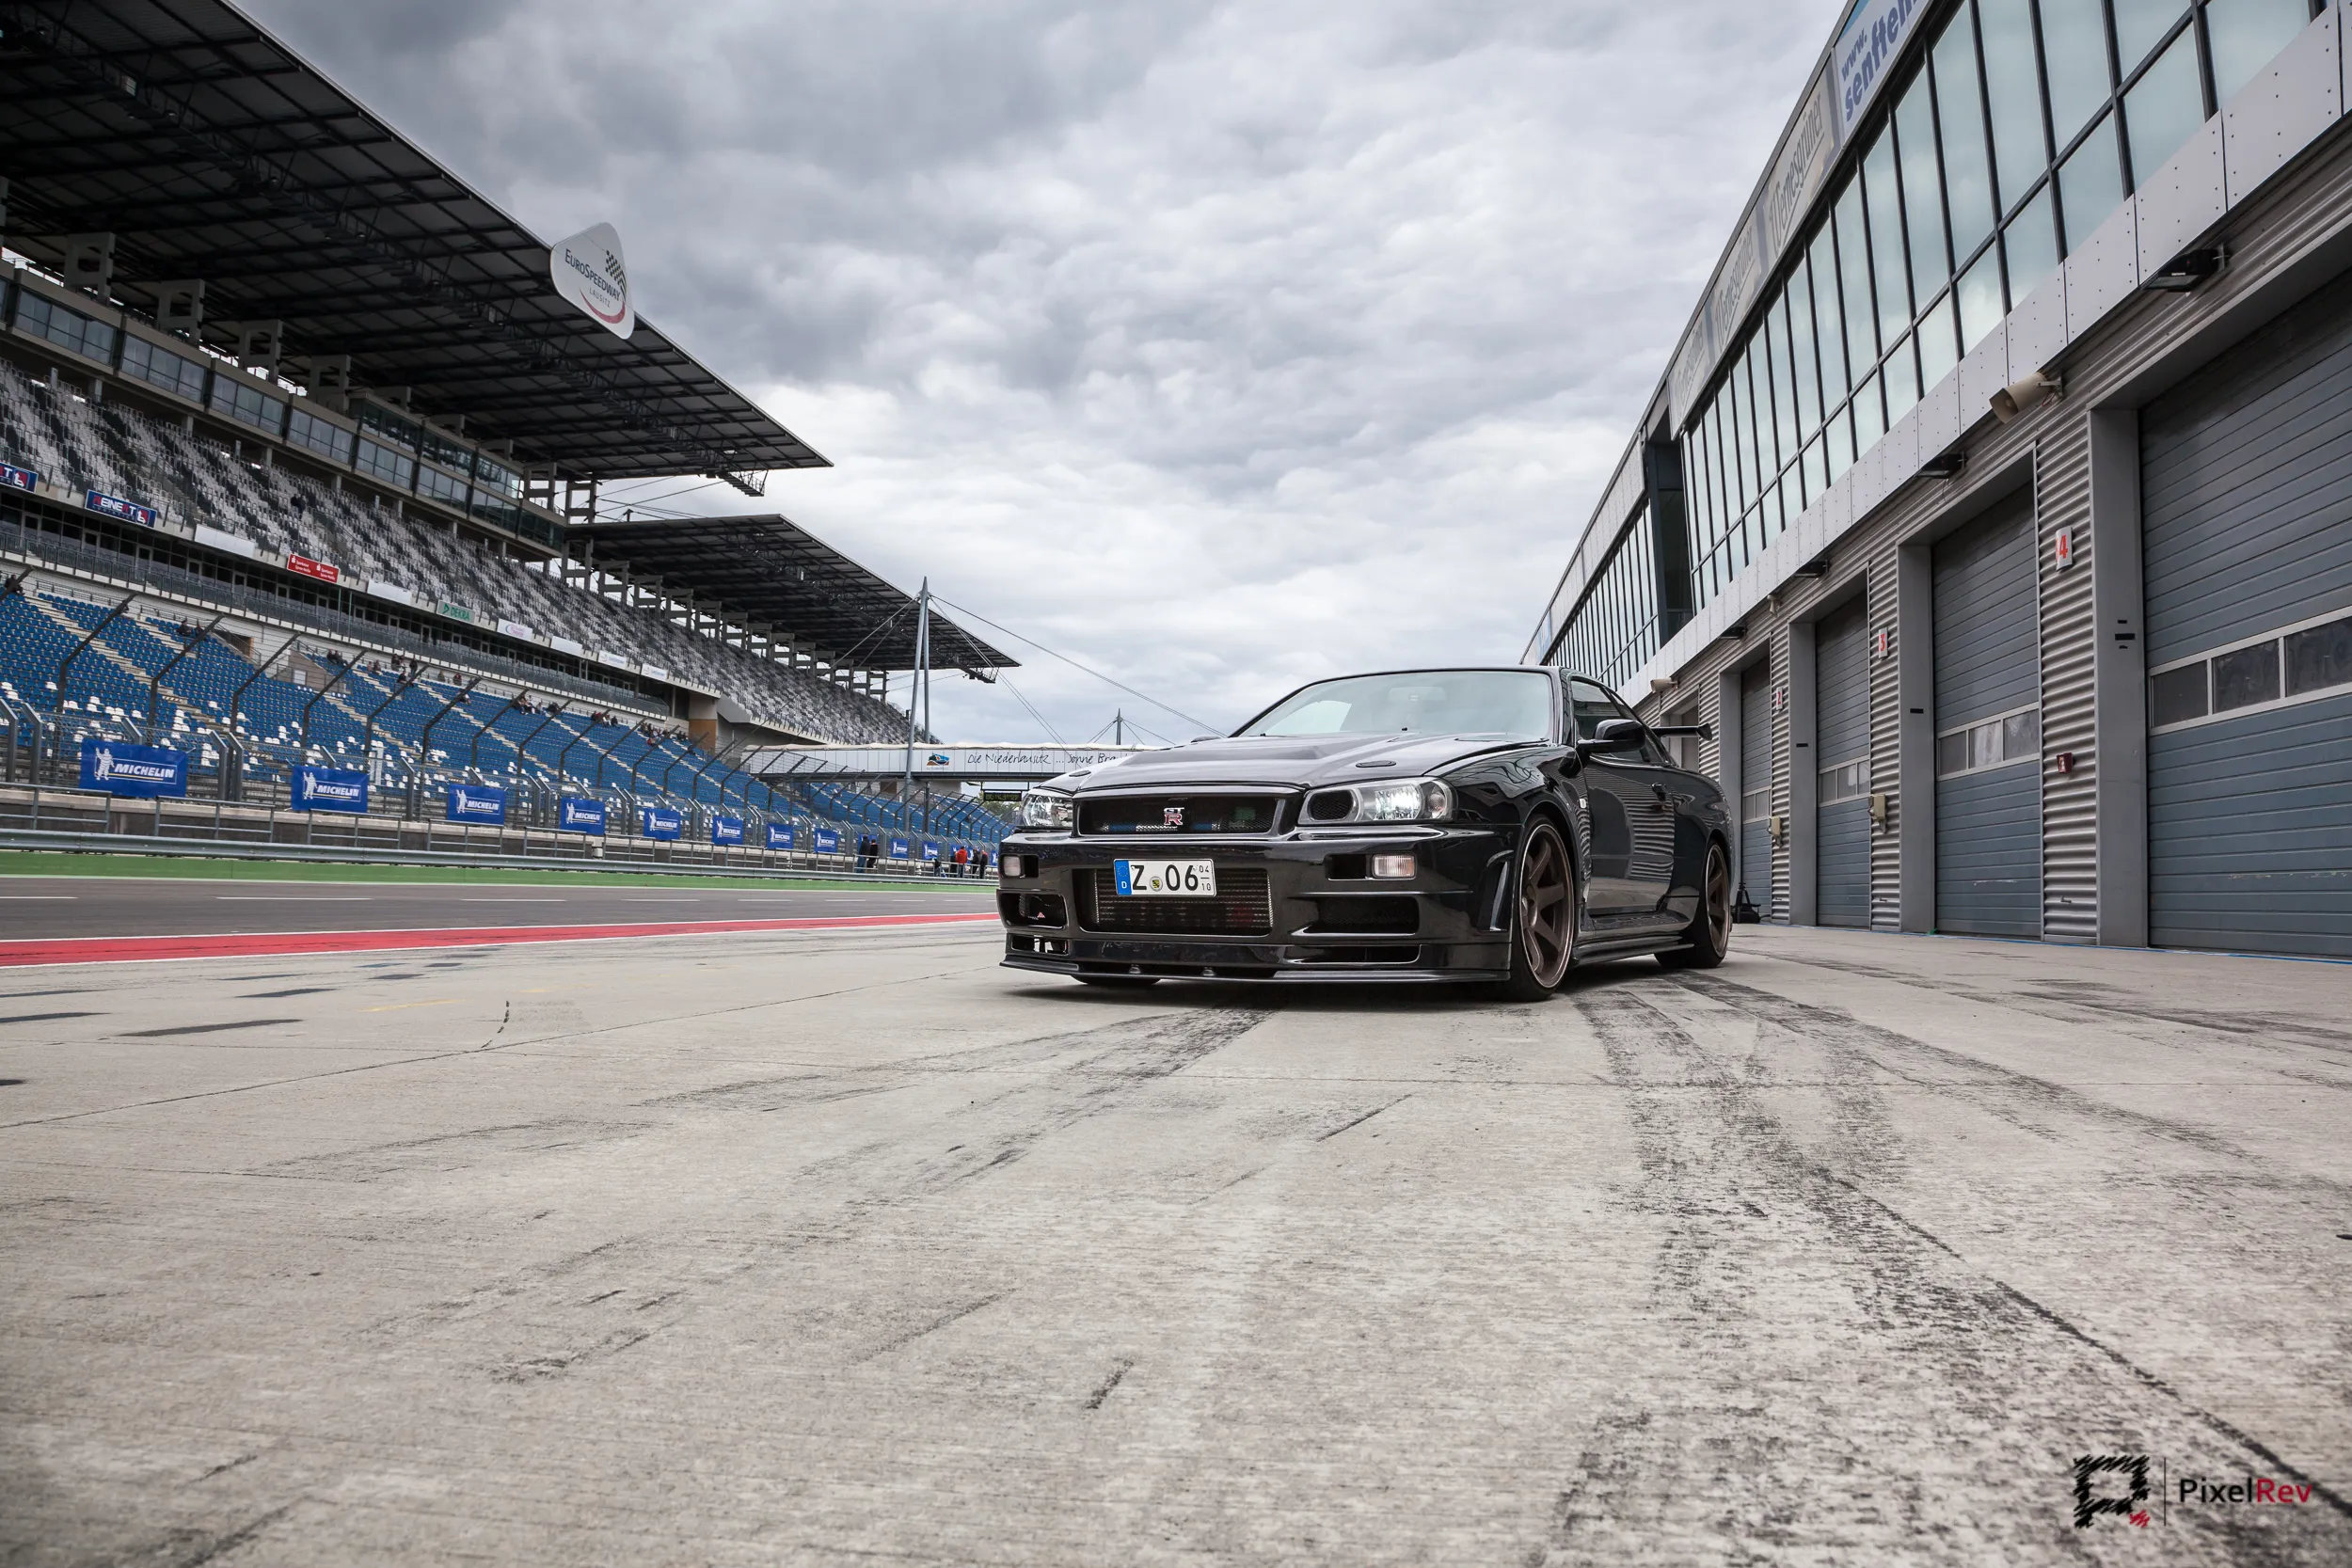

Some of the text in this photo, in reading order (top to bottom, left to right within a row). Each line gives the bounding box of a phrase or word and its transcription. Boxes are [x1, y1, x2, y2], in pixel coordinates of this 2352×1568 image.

[2059, 533, 2069, 560] 4
[451, 606, 470, 621] DEKRA
[1880, 633, 1886, 652] 3
[114, 763, 175, 779] MICHELIN
[316, 784, 360, 798] MICHELIN
[467, 800, 500, 810] MICHELIN
[1163, 814, 1184, 826] R
[1199, 864, 1210, 873] 04
[1120, 880, 1127, 889] D
[1130, 864, 1147, 890] Z
[1201, 882, 1212, 891] 10
